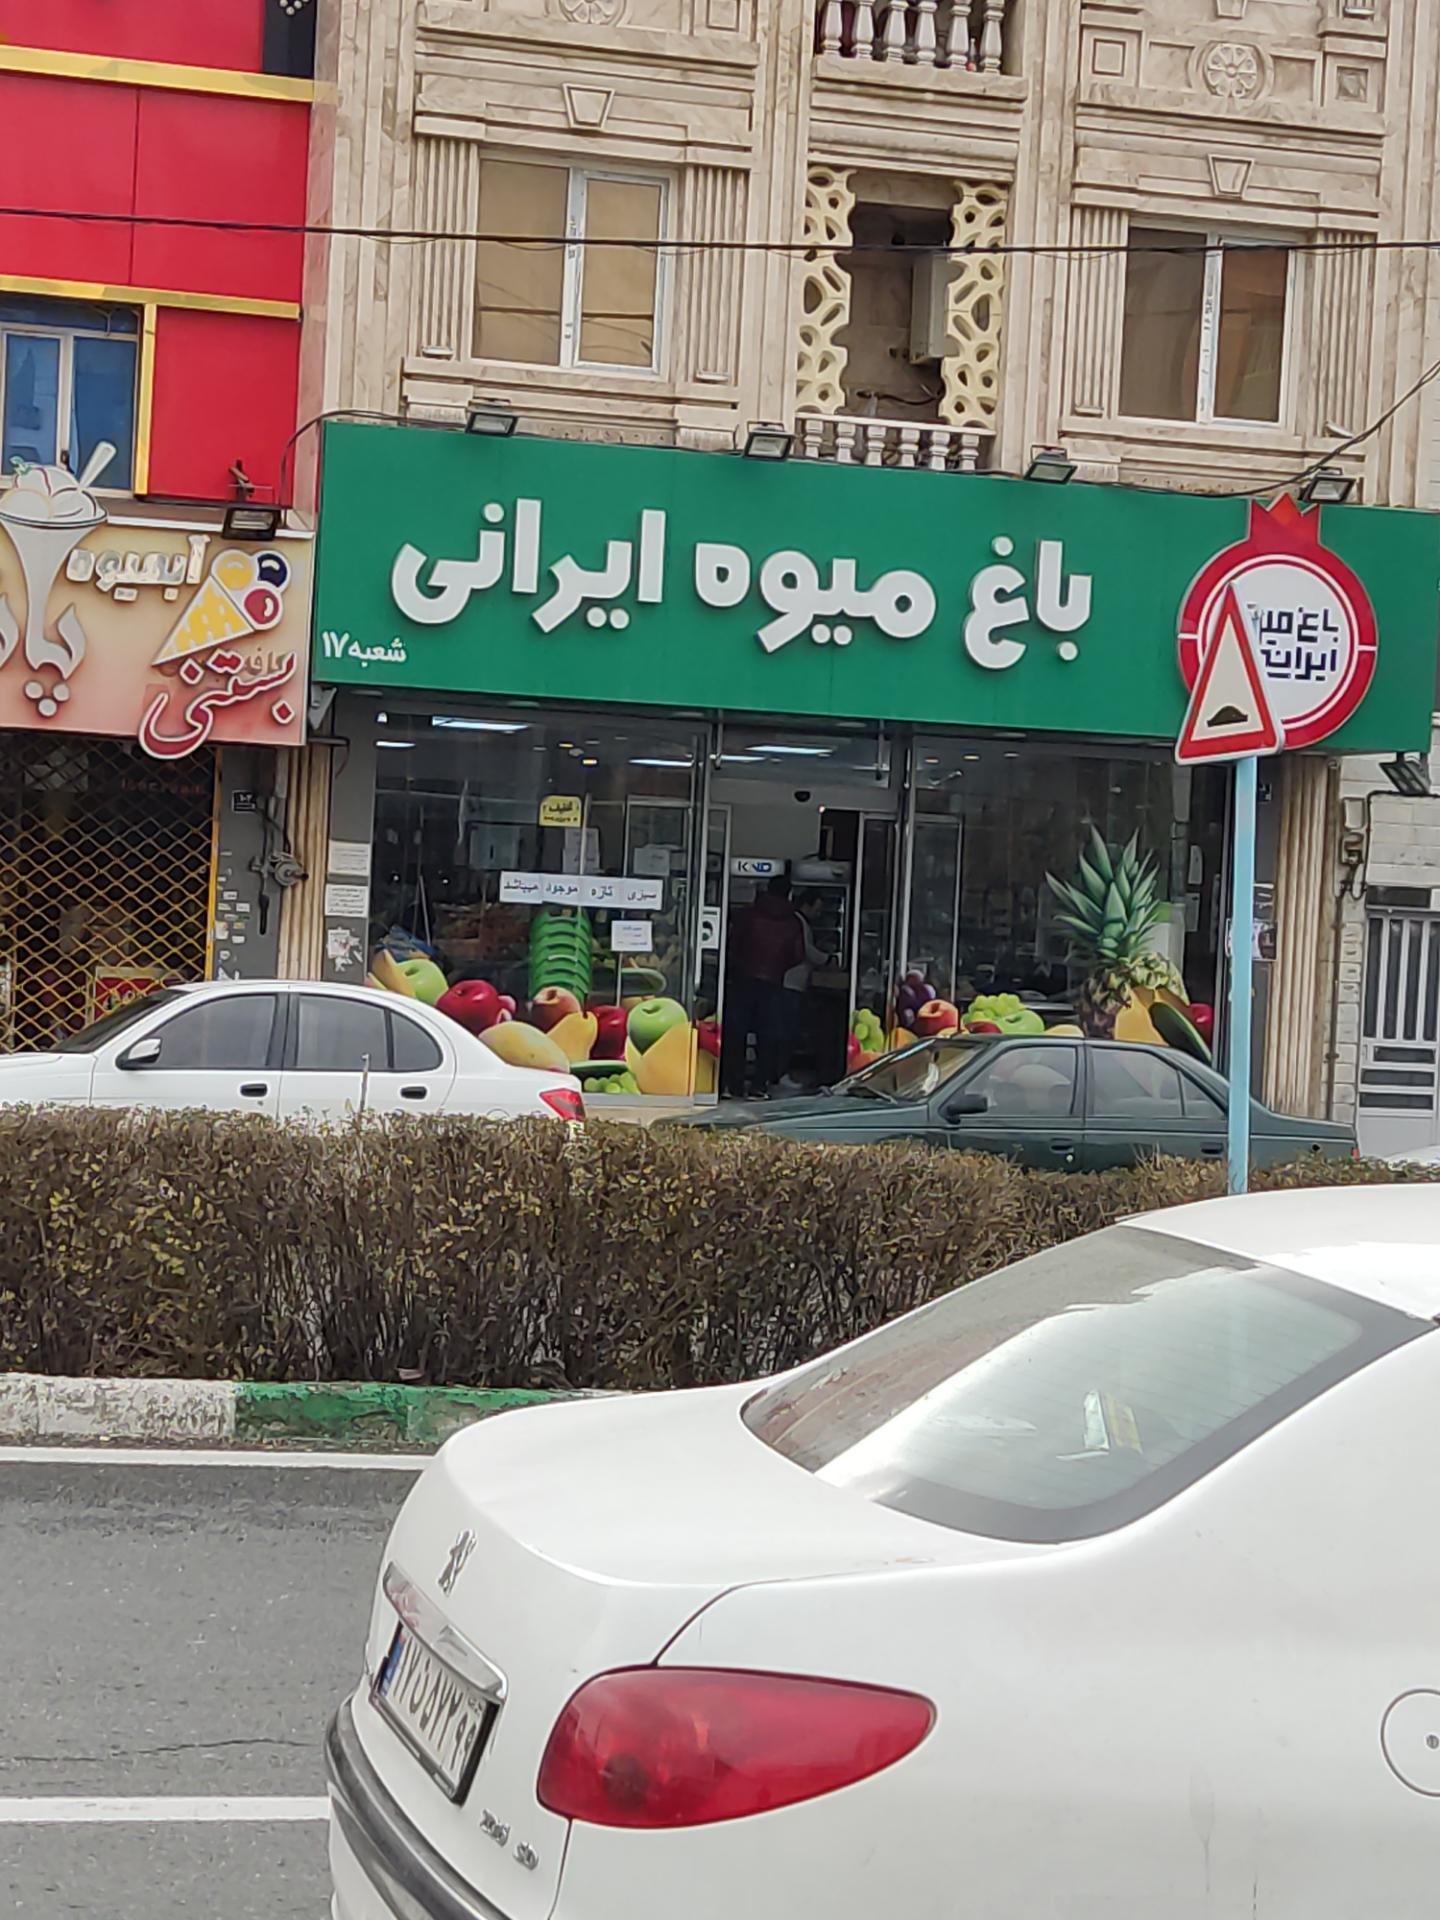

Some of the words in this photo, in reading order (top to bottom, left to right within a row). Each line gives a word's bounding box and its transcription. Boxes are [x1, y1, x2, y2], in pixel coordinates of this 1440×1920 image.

[391, 497, 666, 633] ایرانی
[695, 541, 937, 654] میوه
[964, 535, 1092, 669] باغ
[1297, 606, 1339, 643] باغ
[139, 648, 296, 760] بستنی
[546, 882, 578, 895] موجود
[591, 885, 614, 900] تازه
[627, 891, 657, 902] سبزی
